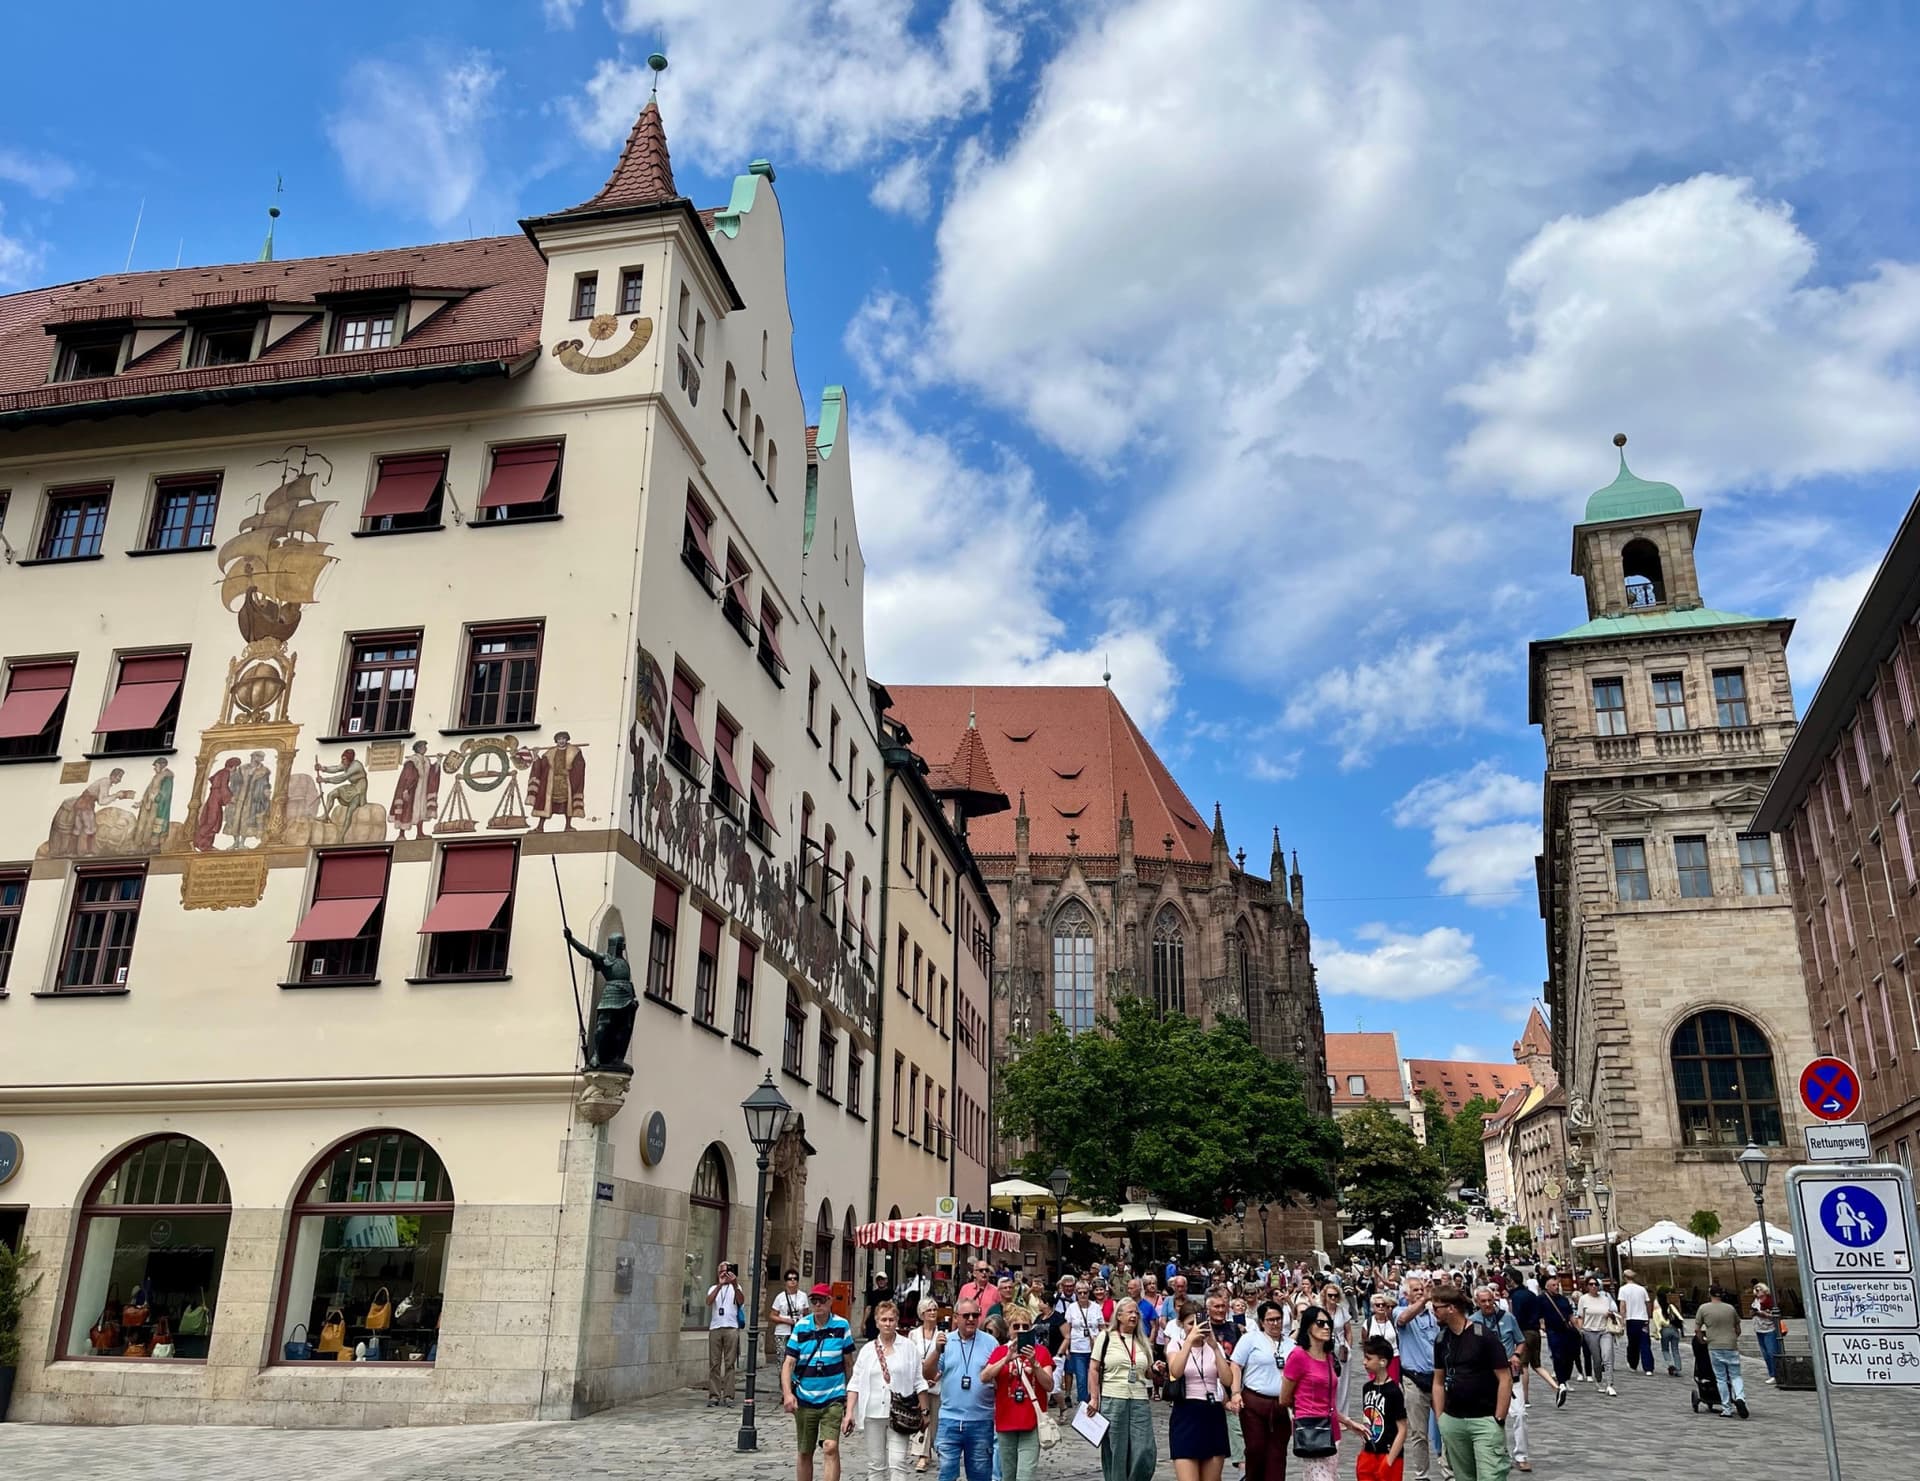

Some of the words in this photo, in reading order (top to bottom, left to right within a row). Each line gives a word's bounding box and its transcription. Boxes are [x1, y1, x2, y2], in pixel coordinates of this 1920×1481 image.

[1810, 1137, 1866, 1150] Rettungsweg
[1834, 1252, 1886, 1267] ZONE
[1822, 1281, 1890, 1291] Lieferverkehr
[1893, 1281, 1908, 1291] bis
[1862, 1314, 1881, 1324] frei
[1843, 1338, 1905, 1350] VAG-Bus
[1831, 1352, 1862, 1366] TAXI
[1867, 1353, 1893, 1366] und
[1867, 1368, 1892, 1380] frei
